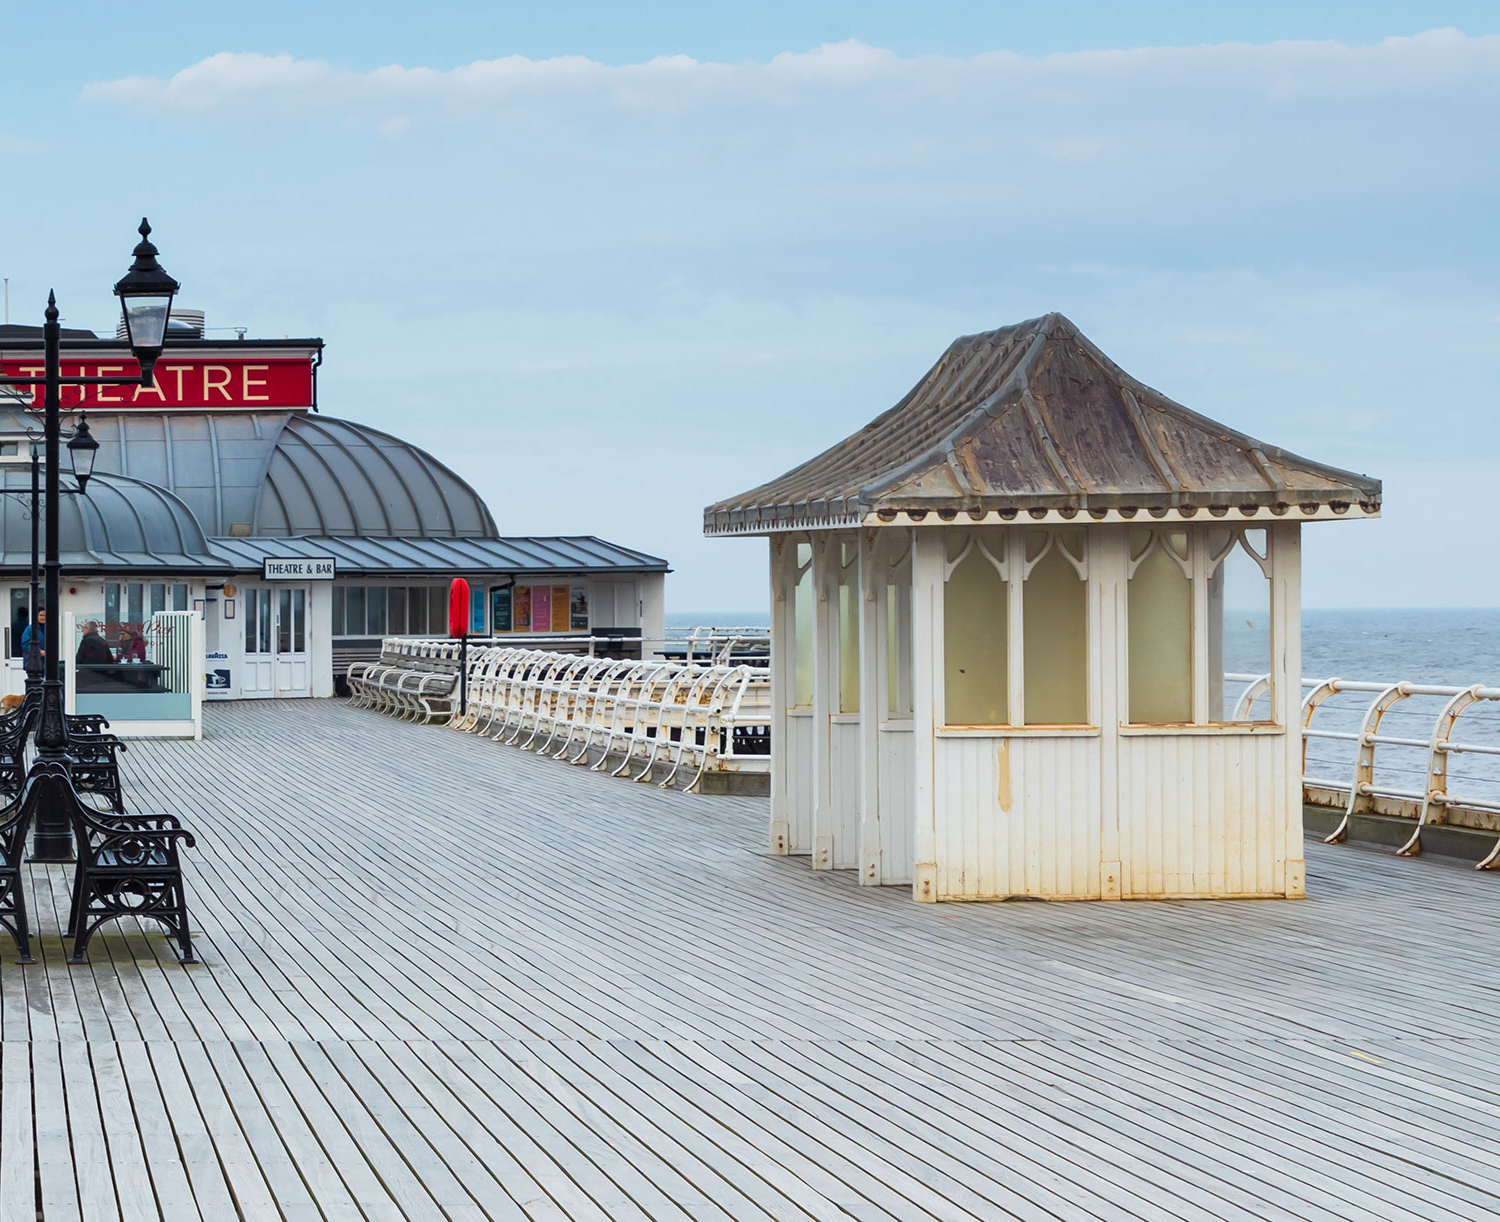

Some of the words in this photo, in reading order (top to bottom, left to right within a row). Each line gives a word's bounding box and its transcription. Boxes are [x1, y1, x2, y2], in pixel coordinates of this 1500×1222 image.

[19, 365, 269, 402] THEATRE
[268, 564, 303, 574] THEATRE
[306, 564, 313, 574] &
[316, 564, 332, 574] BAR
